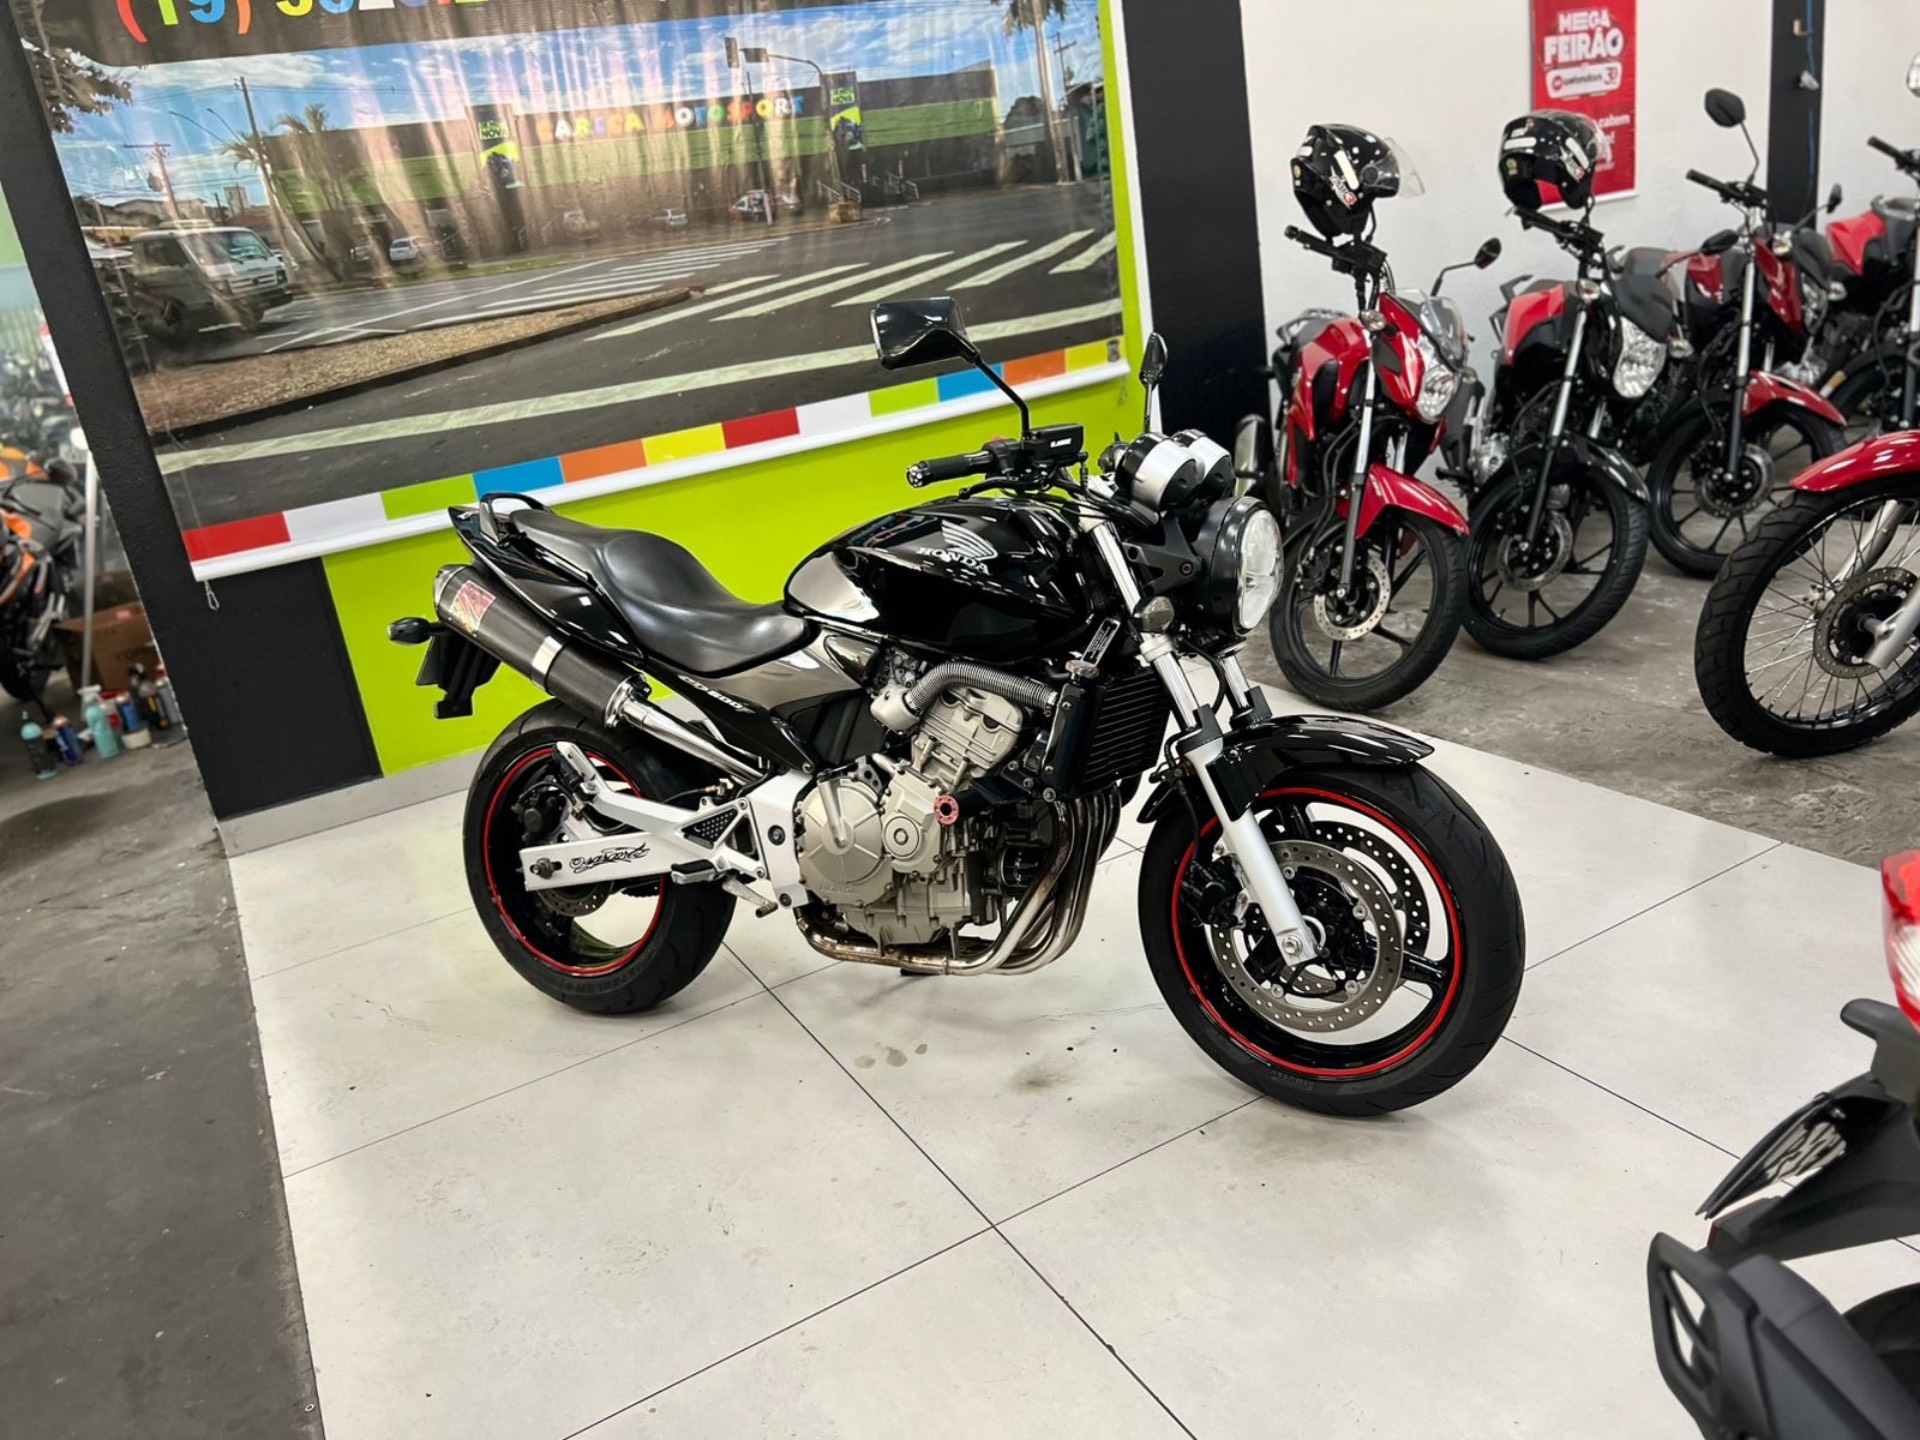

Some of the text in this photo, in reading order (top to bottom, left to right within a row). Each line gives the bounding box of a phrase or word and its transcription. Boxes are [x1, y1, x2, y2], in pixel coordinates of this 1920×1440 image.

[1558, 8, 1611, 33] MEGA
[1543, 27, 1625, 65] FEIRÃO
[916, 546, 991, 577] HONDA
